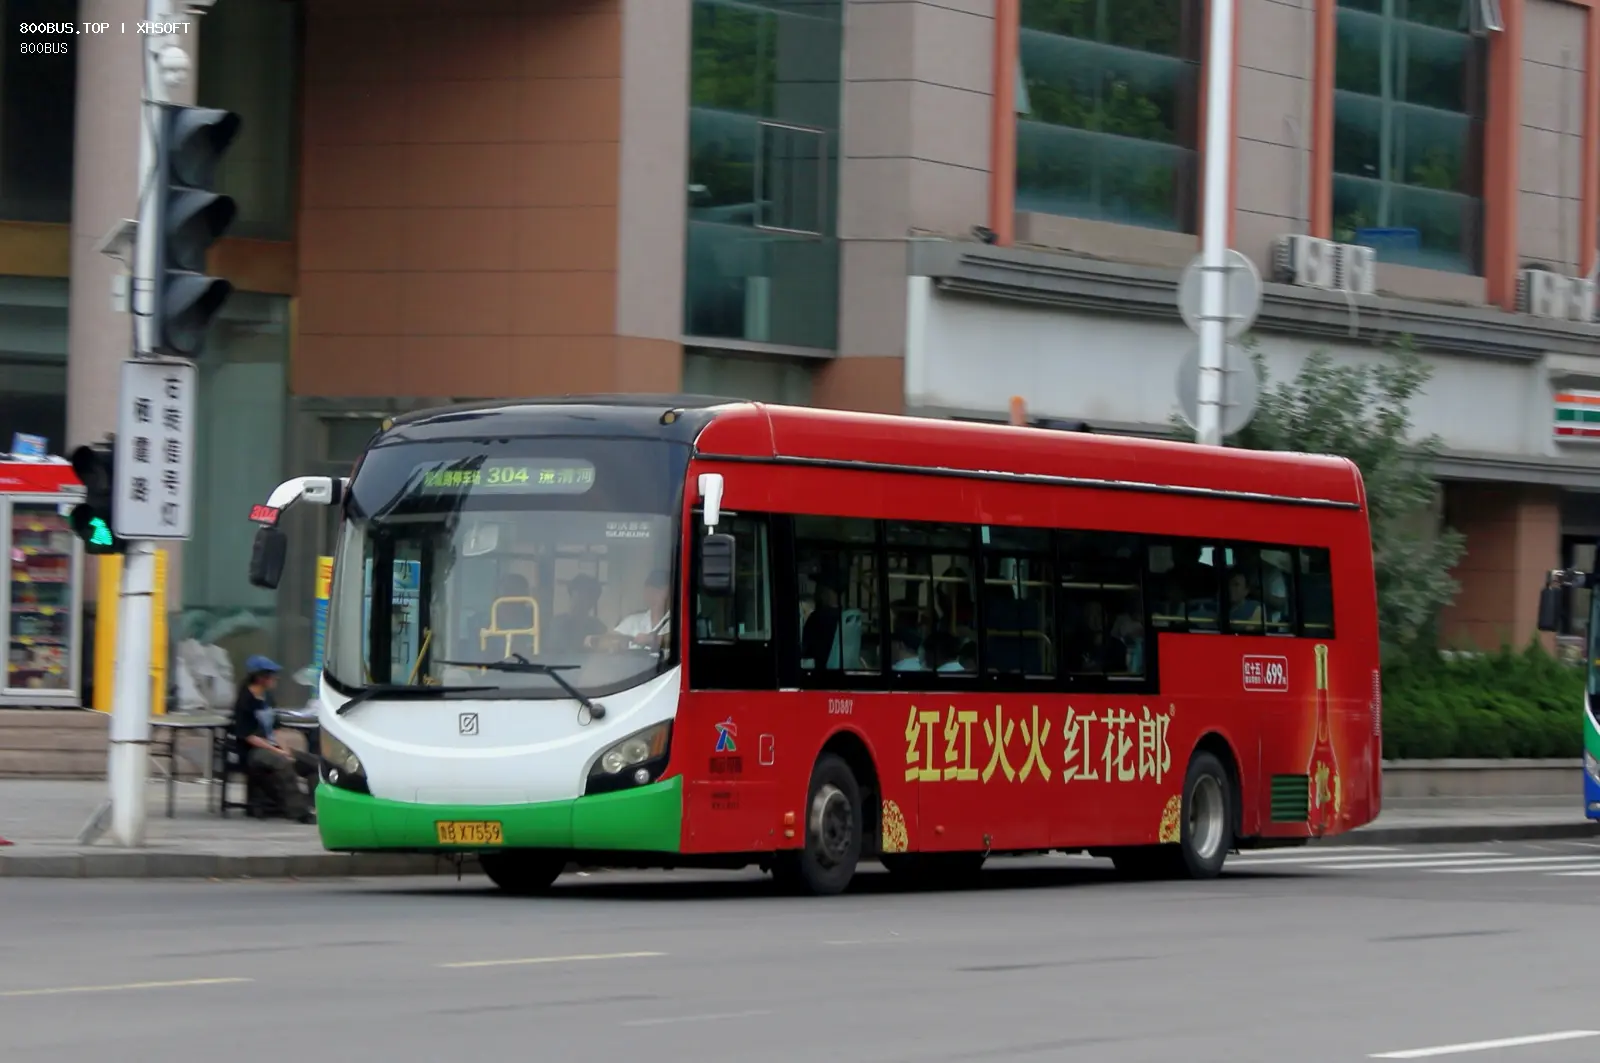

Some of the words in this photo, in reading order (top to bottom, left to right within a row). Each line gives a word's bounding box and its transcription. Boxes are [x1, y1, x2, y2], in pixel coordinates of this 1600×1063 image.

[487, 467, 529, 483] 304
[250, 504, 277, 522] 304
[905, 704, 1052, 784] 红红火火
[1063, 704, 1171, 785] 红花郎
